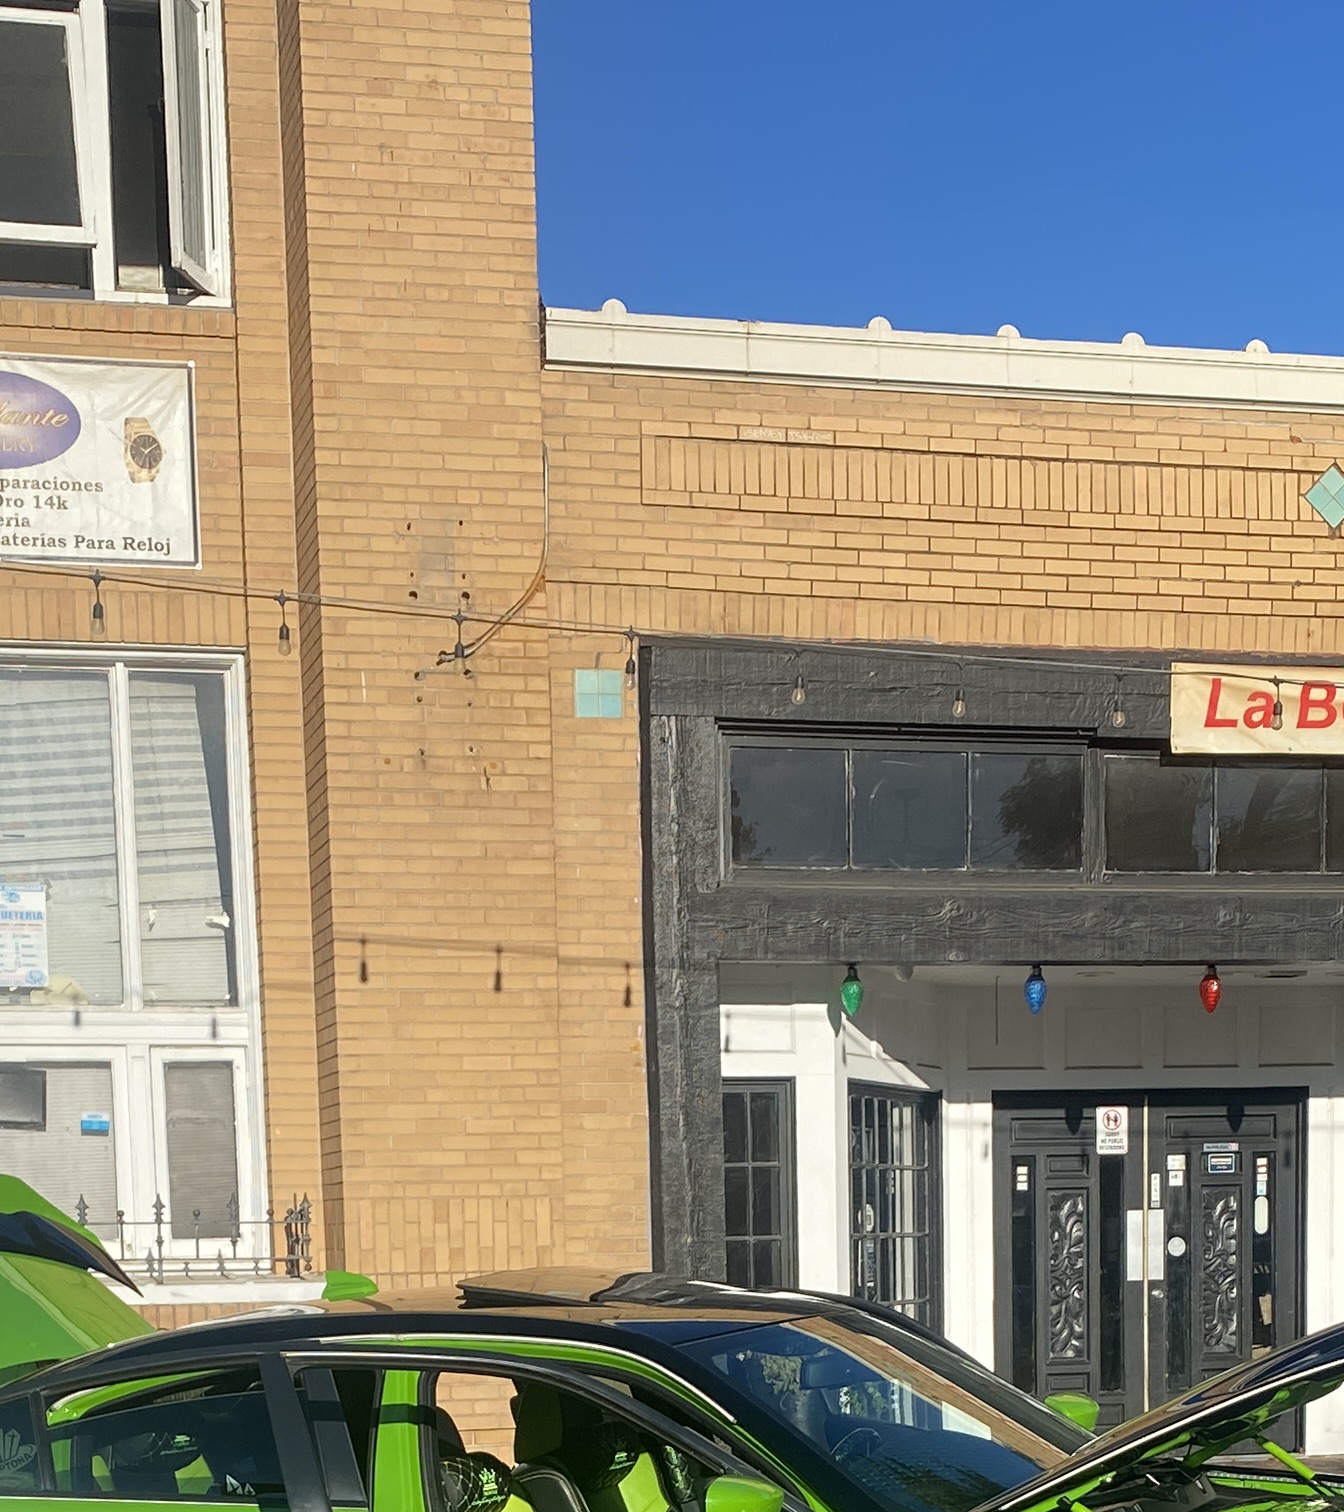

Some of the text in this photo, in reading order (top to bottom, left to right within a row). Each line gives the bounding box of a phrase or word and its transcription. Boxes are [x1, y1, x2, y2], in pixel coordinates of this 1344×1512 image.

[33, 494, 68, 511] 14k
[74, 534, 116, 551] Para
[122, 536, 172, 556] Reloj
[1203, 678, 1274, 729] La
